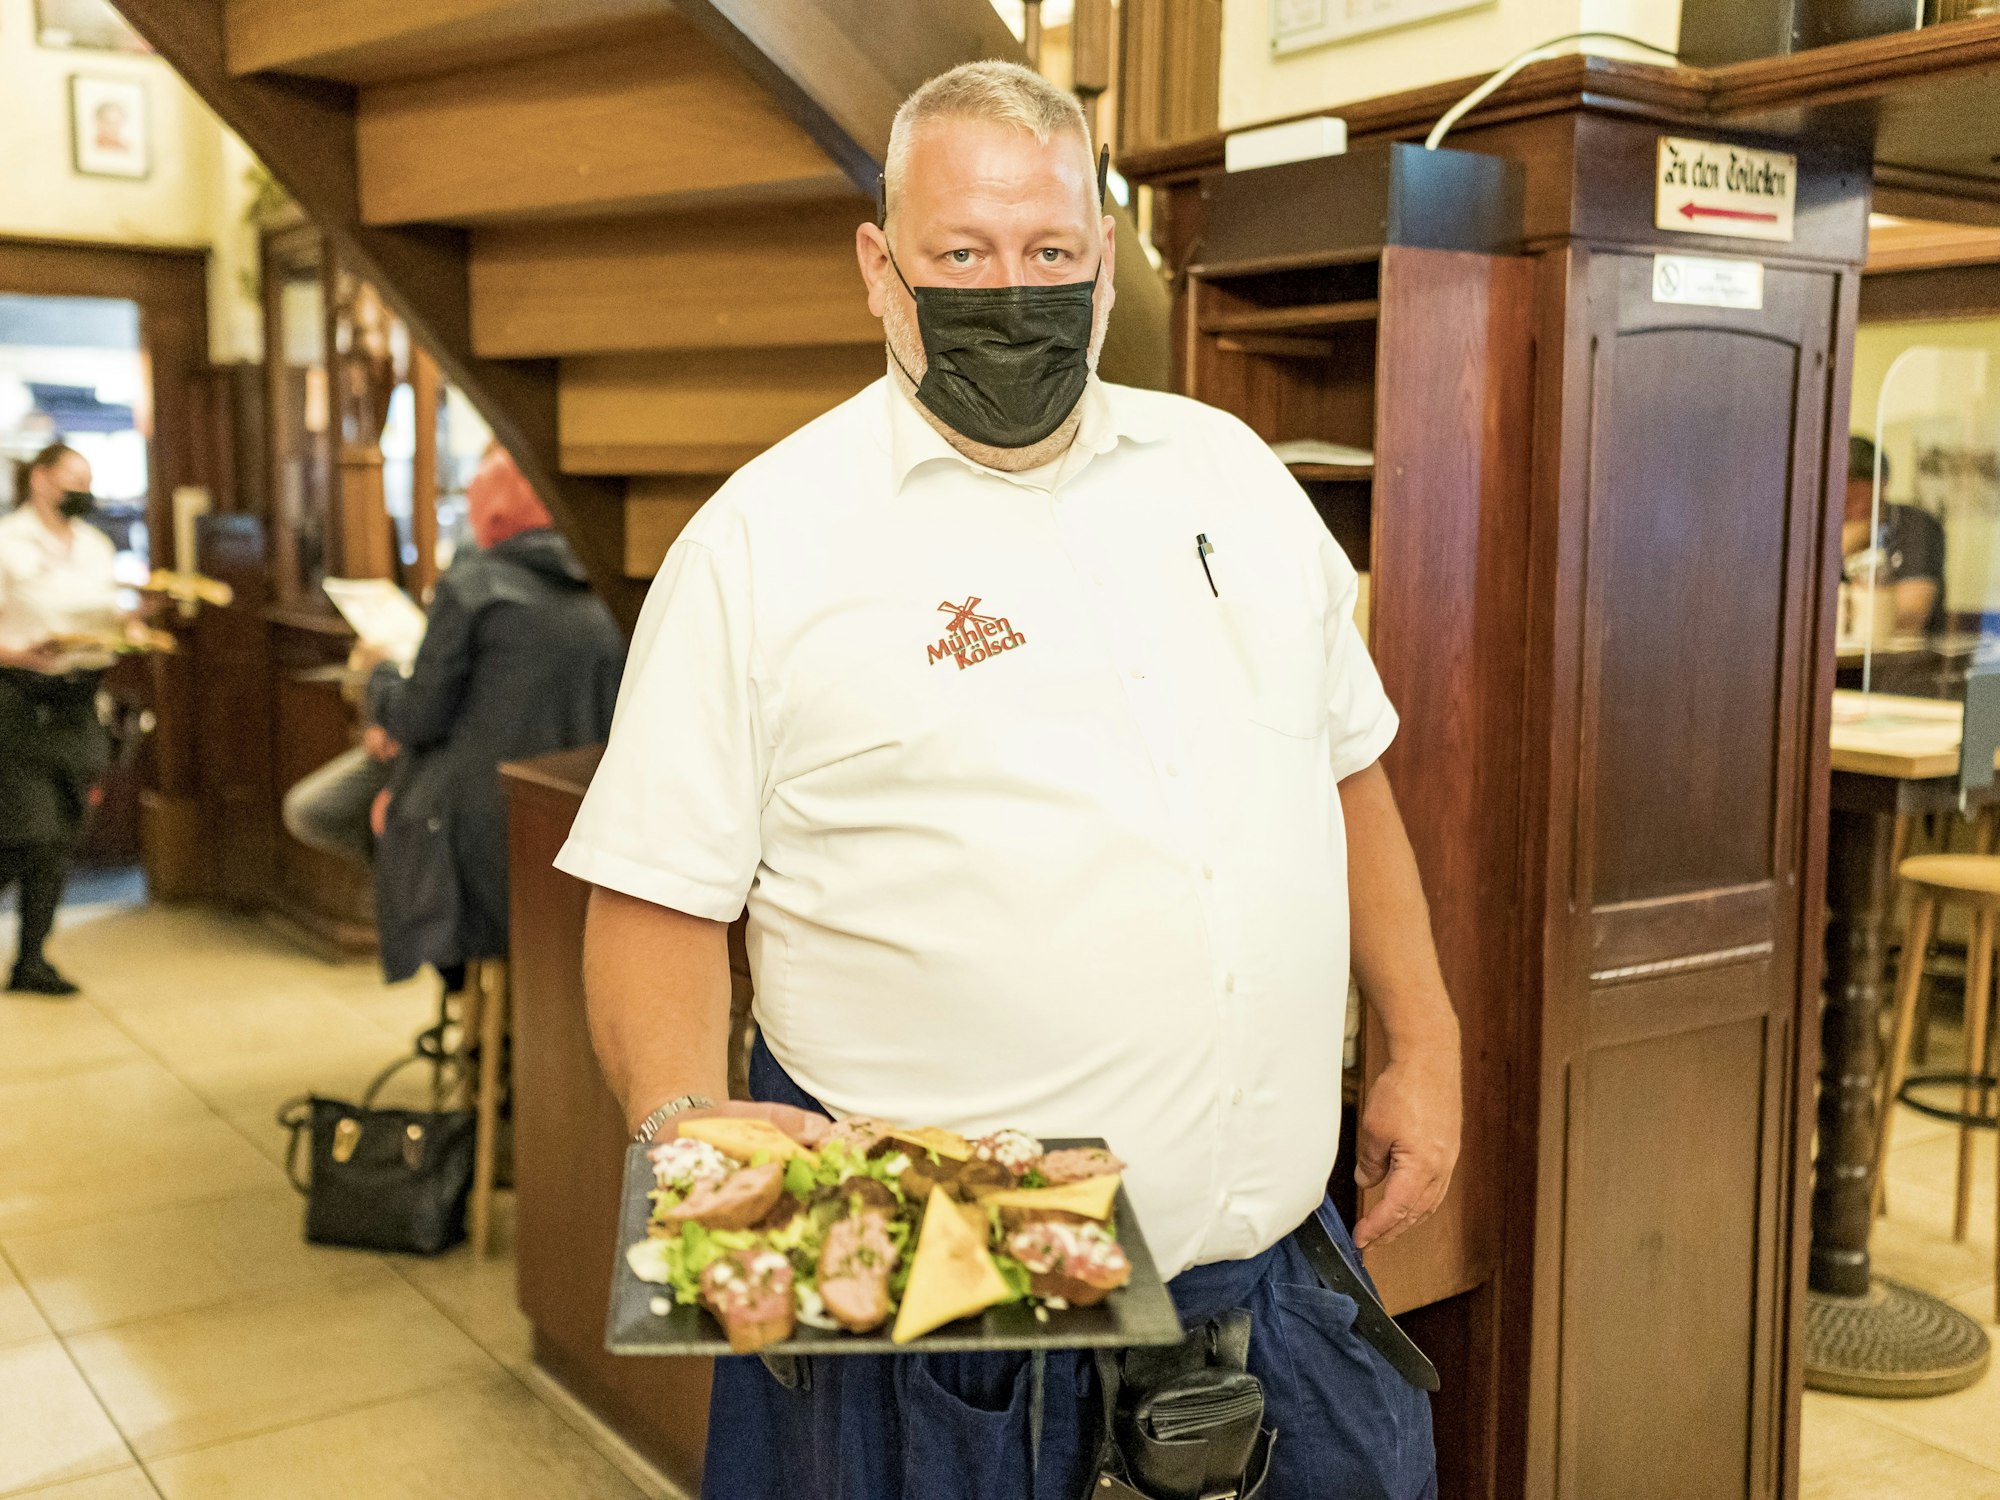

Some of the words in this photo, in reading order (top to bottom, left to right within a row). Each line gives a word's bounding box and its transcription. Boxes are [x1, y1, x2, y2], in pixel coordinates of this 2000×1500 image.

[1665, 145, 1687, 184] Zu
[1692, 152, 1719, 189] den
[926, 617, 1013, 666] Mühlen
[954, 626, 1026, 670] Kölsch
